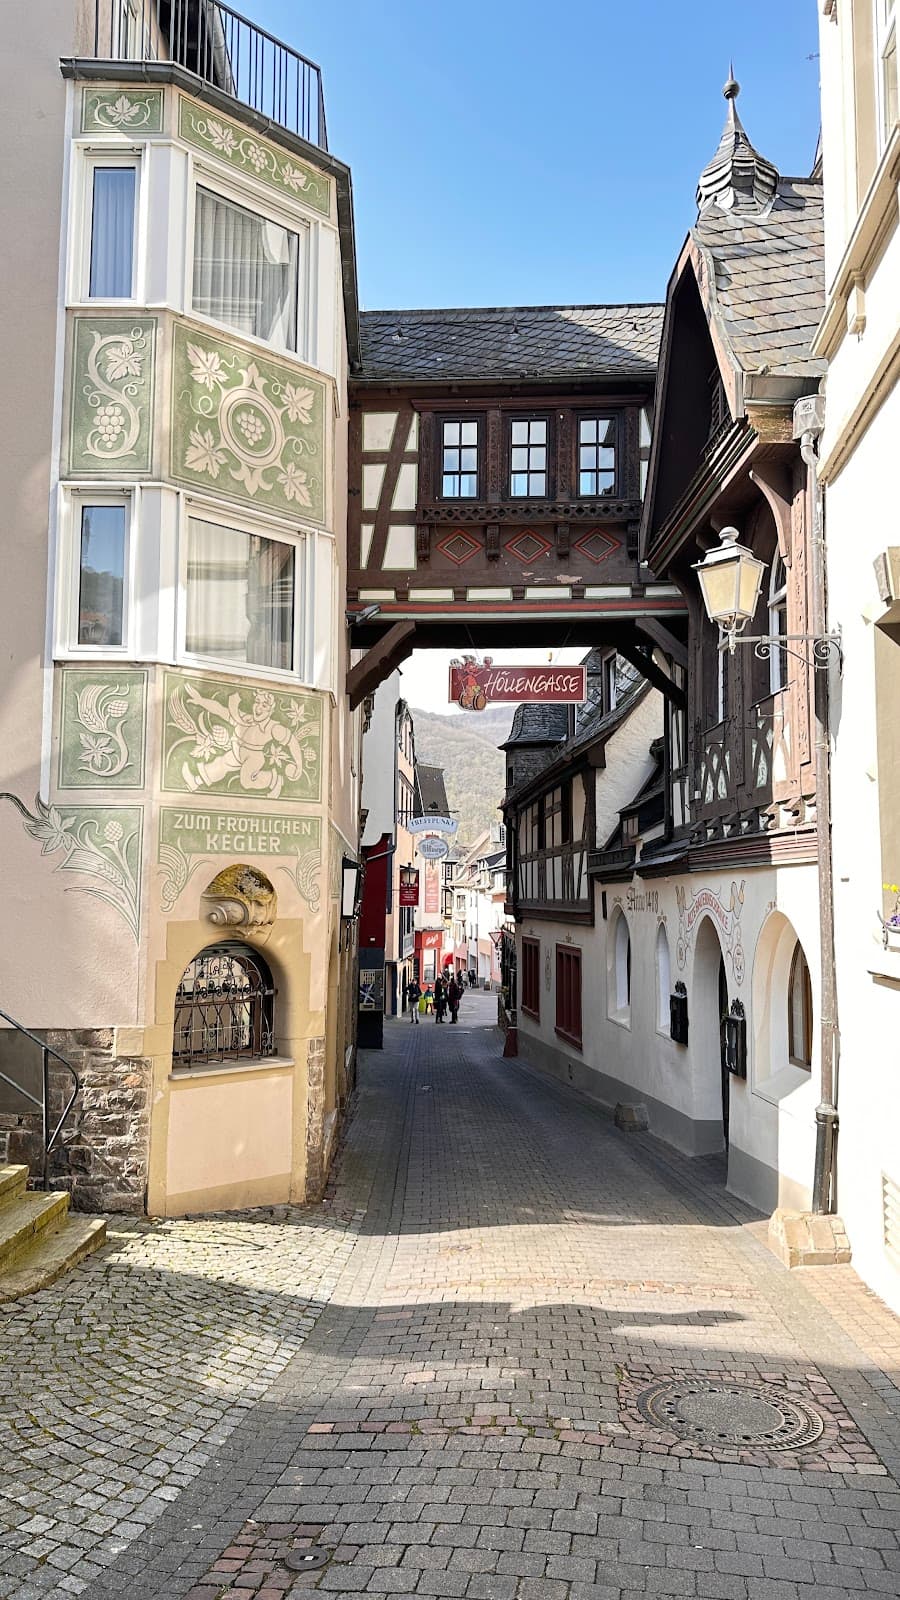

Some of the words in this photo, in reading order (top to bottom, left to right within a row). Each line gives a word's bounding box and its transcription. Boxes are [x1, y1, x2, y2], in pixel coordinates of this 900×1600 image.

[484, 670, 580, 696] HÖLLENGASSE
[173, 813, 211, 831] ZUM
[217, 816, 312, 835] FRÖHLICHEN
[206, 833, 281, 853] KEGLER
